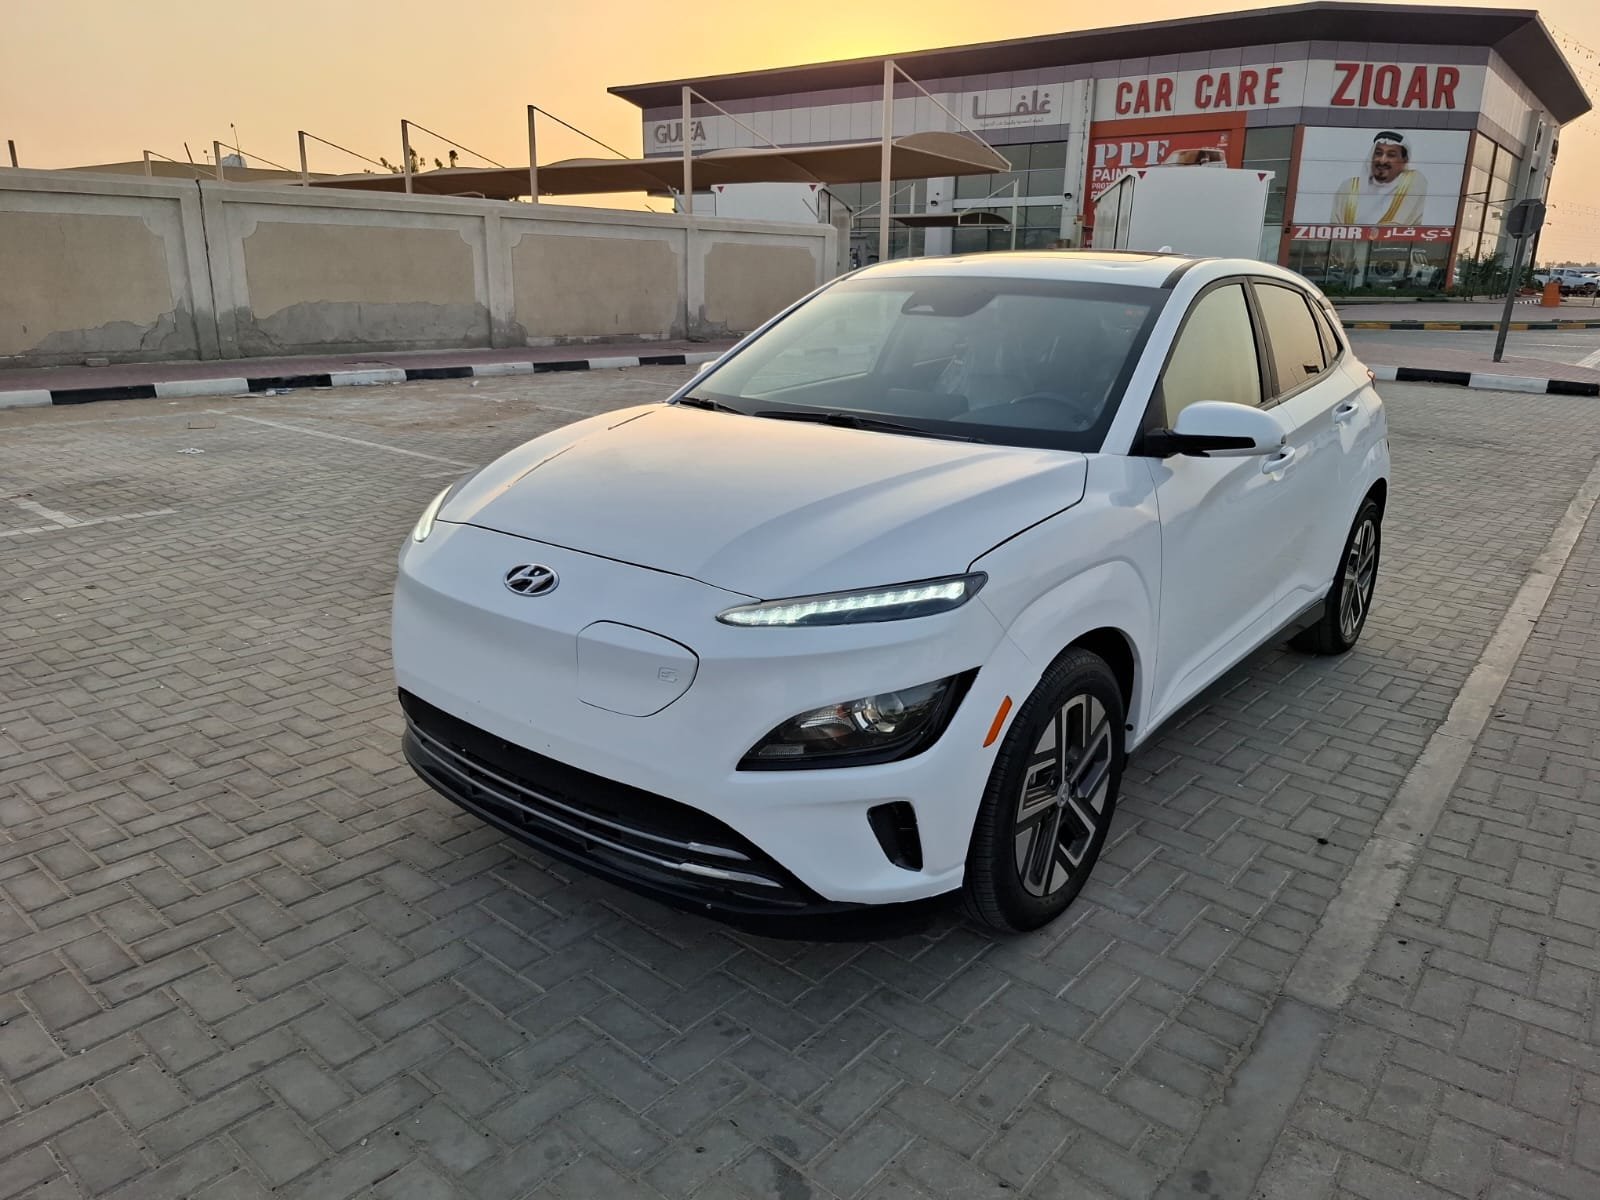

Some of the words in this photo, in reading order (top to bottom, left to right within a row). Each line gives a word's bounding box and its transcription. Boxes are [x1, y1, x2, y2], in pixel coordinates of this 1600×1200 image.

[1115, 77, 1174, 115] CAR
[1194, 67, 1283, 109] CARE
[1330, 63, 1460, 110] ZIQAR
[1093, 140, 1170, 168] PPF
[1294, 225, 1363, 240] ZIQAR
[1384, 227, 1416, 238] قار
[1420, 227, 1452, 241] ذي
